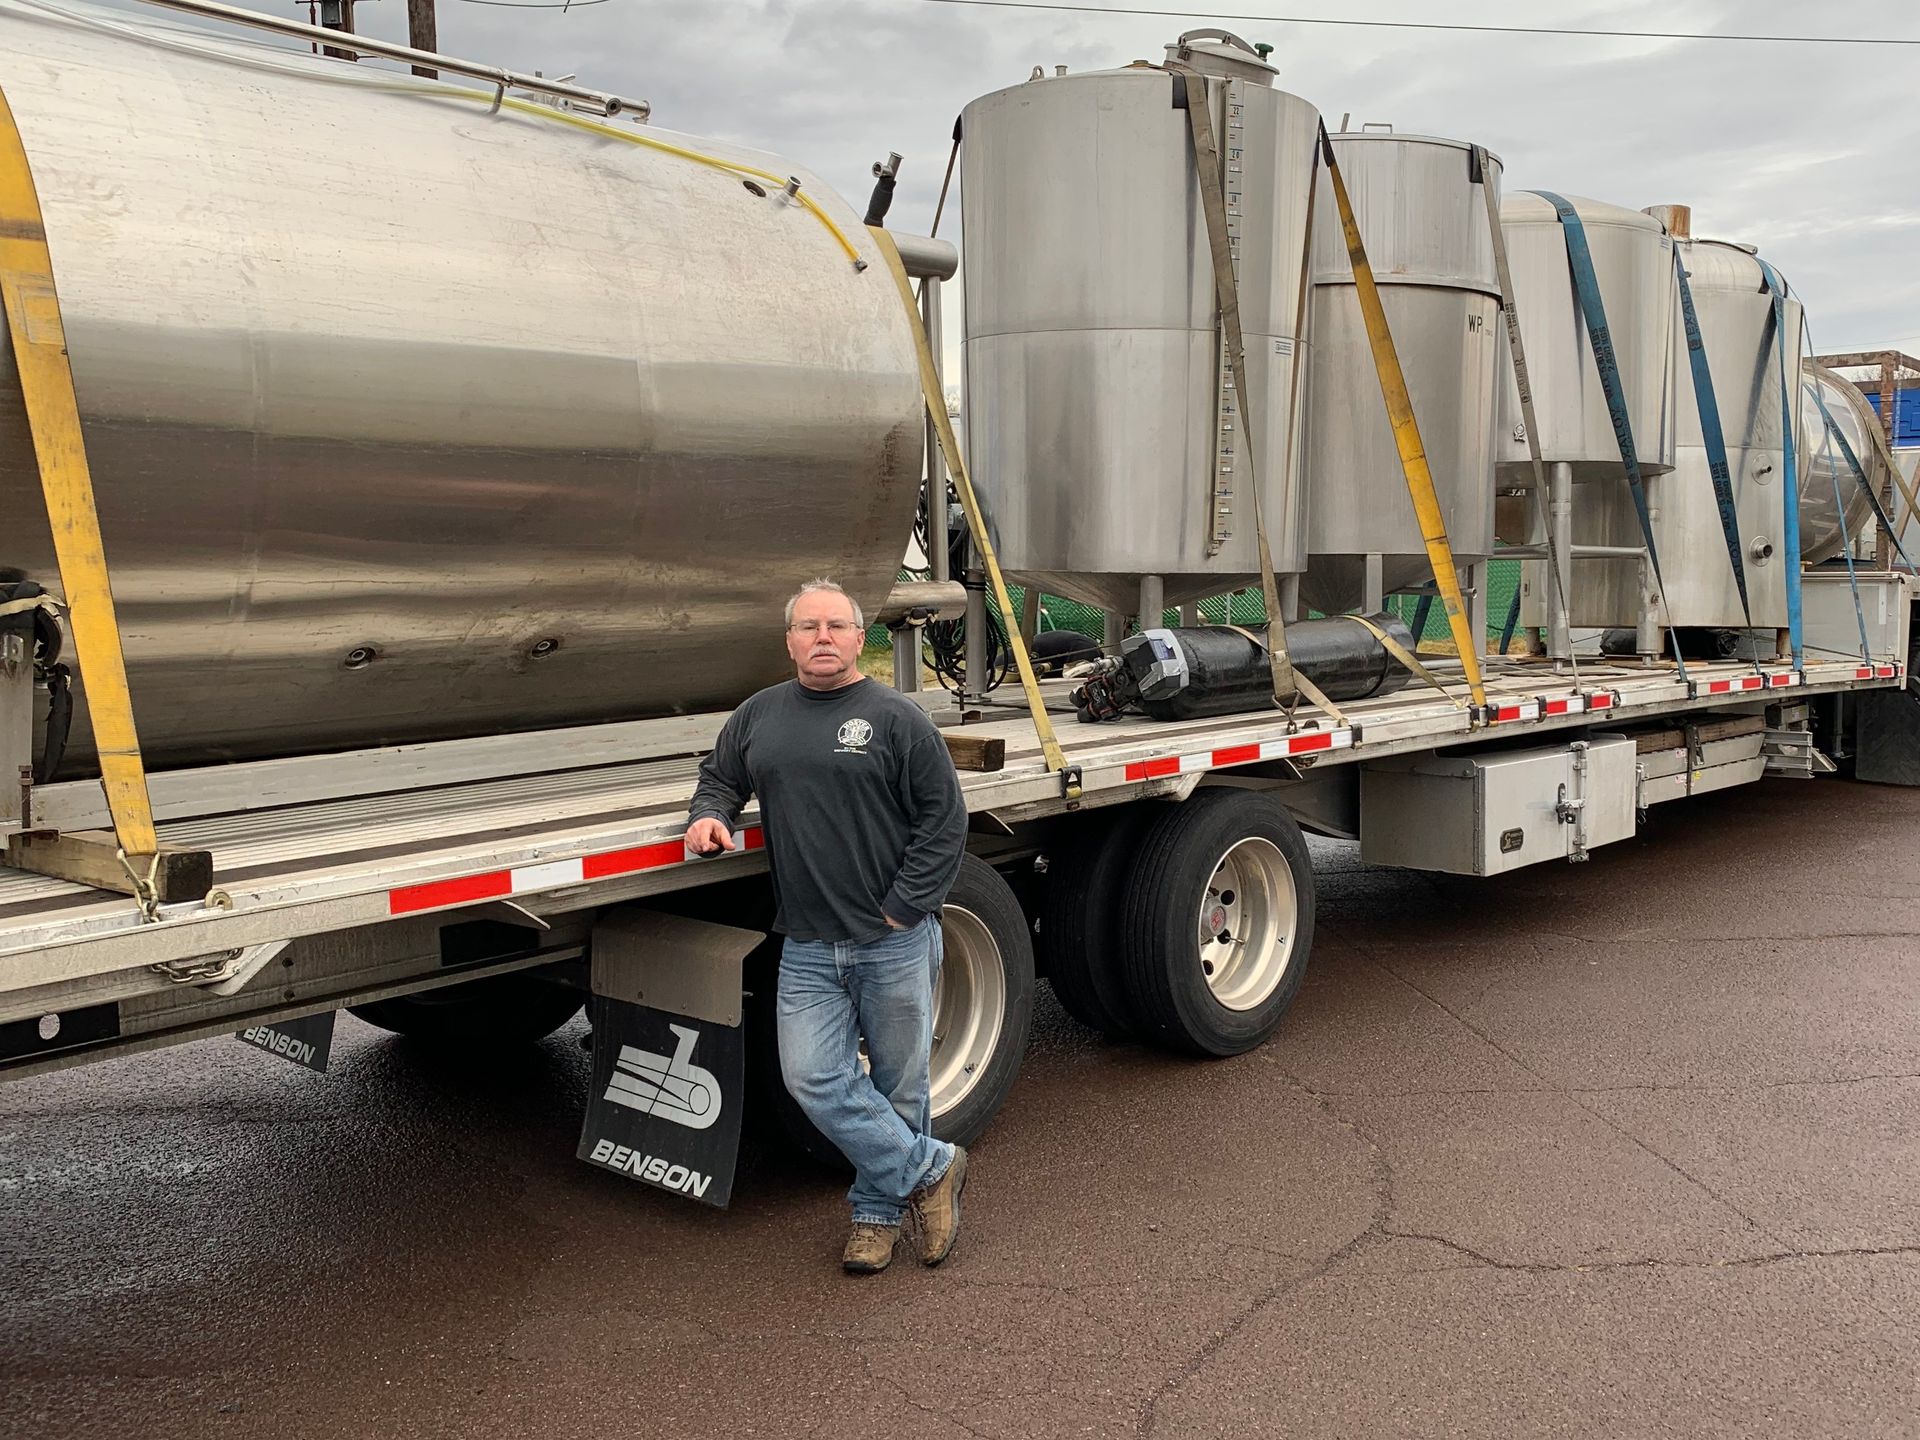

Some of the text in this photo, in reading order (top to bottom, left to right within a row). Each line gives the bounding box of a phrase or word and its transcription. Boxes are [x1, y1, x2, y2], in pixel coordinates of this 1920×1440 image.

[1233, 107, 1240, 115] 22
[1468, 314, 1483, 333] WP
[243, 1025, 316, 1064] BENSON
[590, 1139, 712, 1198] BENSON
